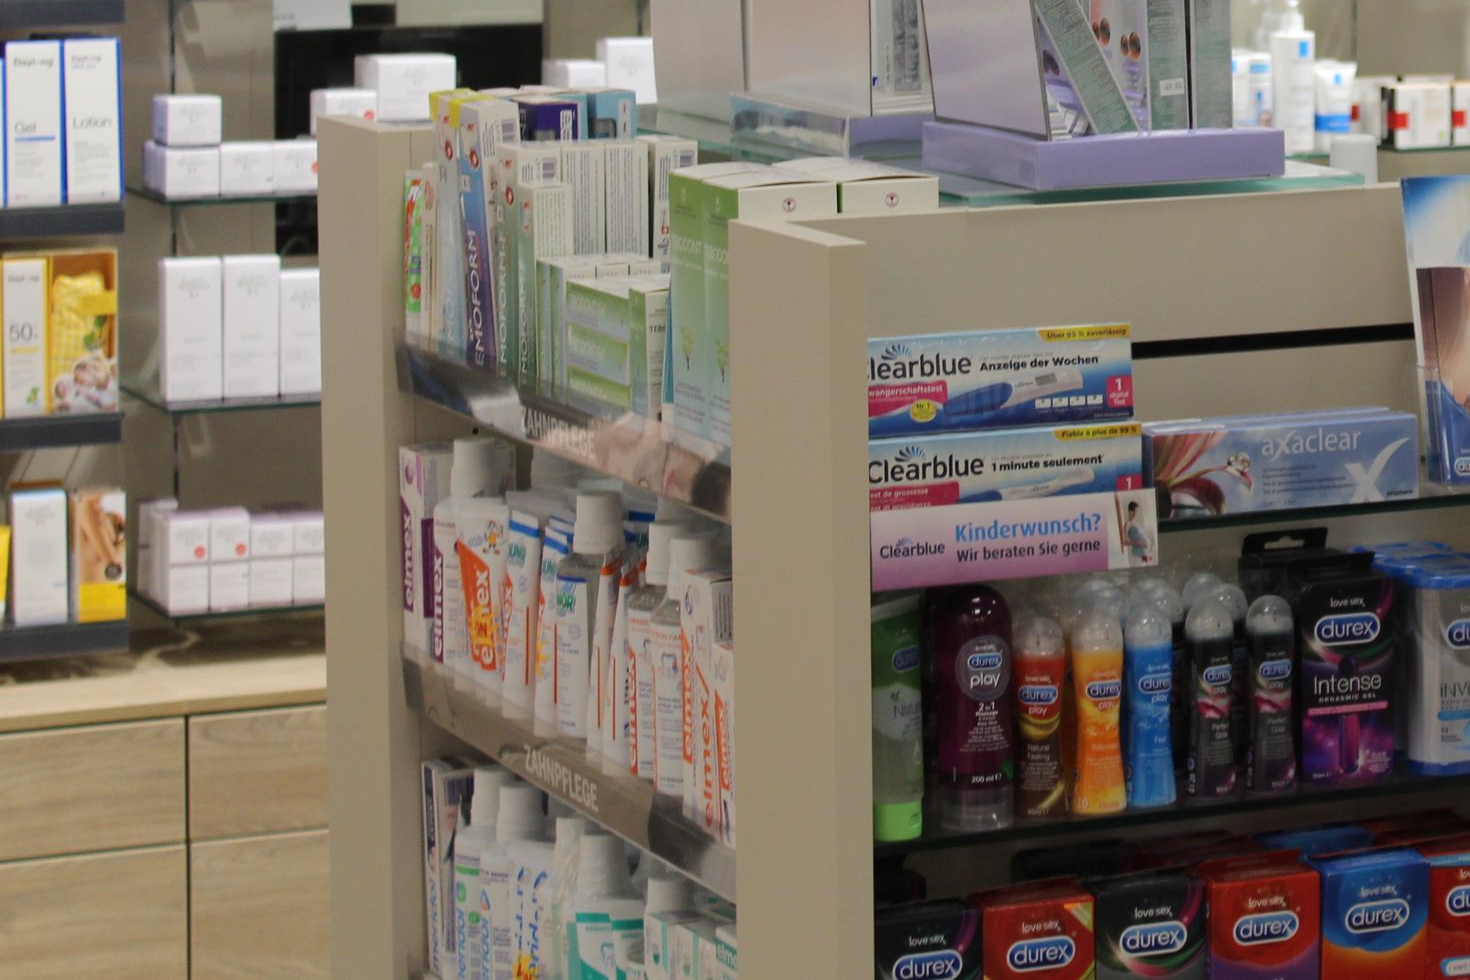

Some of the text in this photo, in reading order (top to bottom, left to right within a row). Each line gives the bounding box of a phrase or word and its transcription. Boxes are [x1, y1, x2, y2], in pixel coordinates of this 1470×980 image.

[15, 121, 37, 136] Gel
[72, 116, 112, 129] Lotion
[468, 229, 485, 367] EMOFORM
[868, 353, 971, 380] learblue
[980, 356, 1099, 372] Anzeige der Wochen
[1116, 379, 1122, 391] 1
[1261, 427, 1362, 461] axaclear
[869, 455, 985, 484] Clearblue
[992, 455, 1103, 471] 1 minute seulement
[1126, 478, 1131, 489] 1
[955, 513, 1101, 543] Kinderwunsch?
[404, 514, 413, 606] elmex
[880, 541, 945, 560] Clearblue
[957, 540, 1100, 562] Wir beraten Sie gerne
[434, 555, 442, 655] elmex
[1321, 620, 1375, 639] durex
[972, 655, 1000, 668] durex
[970, 673, 1000, 689] play
[1314, 675, 1382, 695] Intense
[1028, 706, 1047, 716] play
[701, 699, 714, 828] elmex
[524, 745, 600, 813] ZAHNPFLEGE
[1360, 885, 1398, 898] love sex
[1134, 905, 1173, 919] love sex
[1352, 907, 1404, 927] durex
[1240, 918, 1293, 939] durex
[909, 933, 946, 947] love sex
[1126, 928, 1184, 950] durex
[1013, 944, 1071, 966] durex
[900, 956, 955, 979] durex
